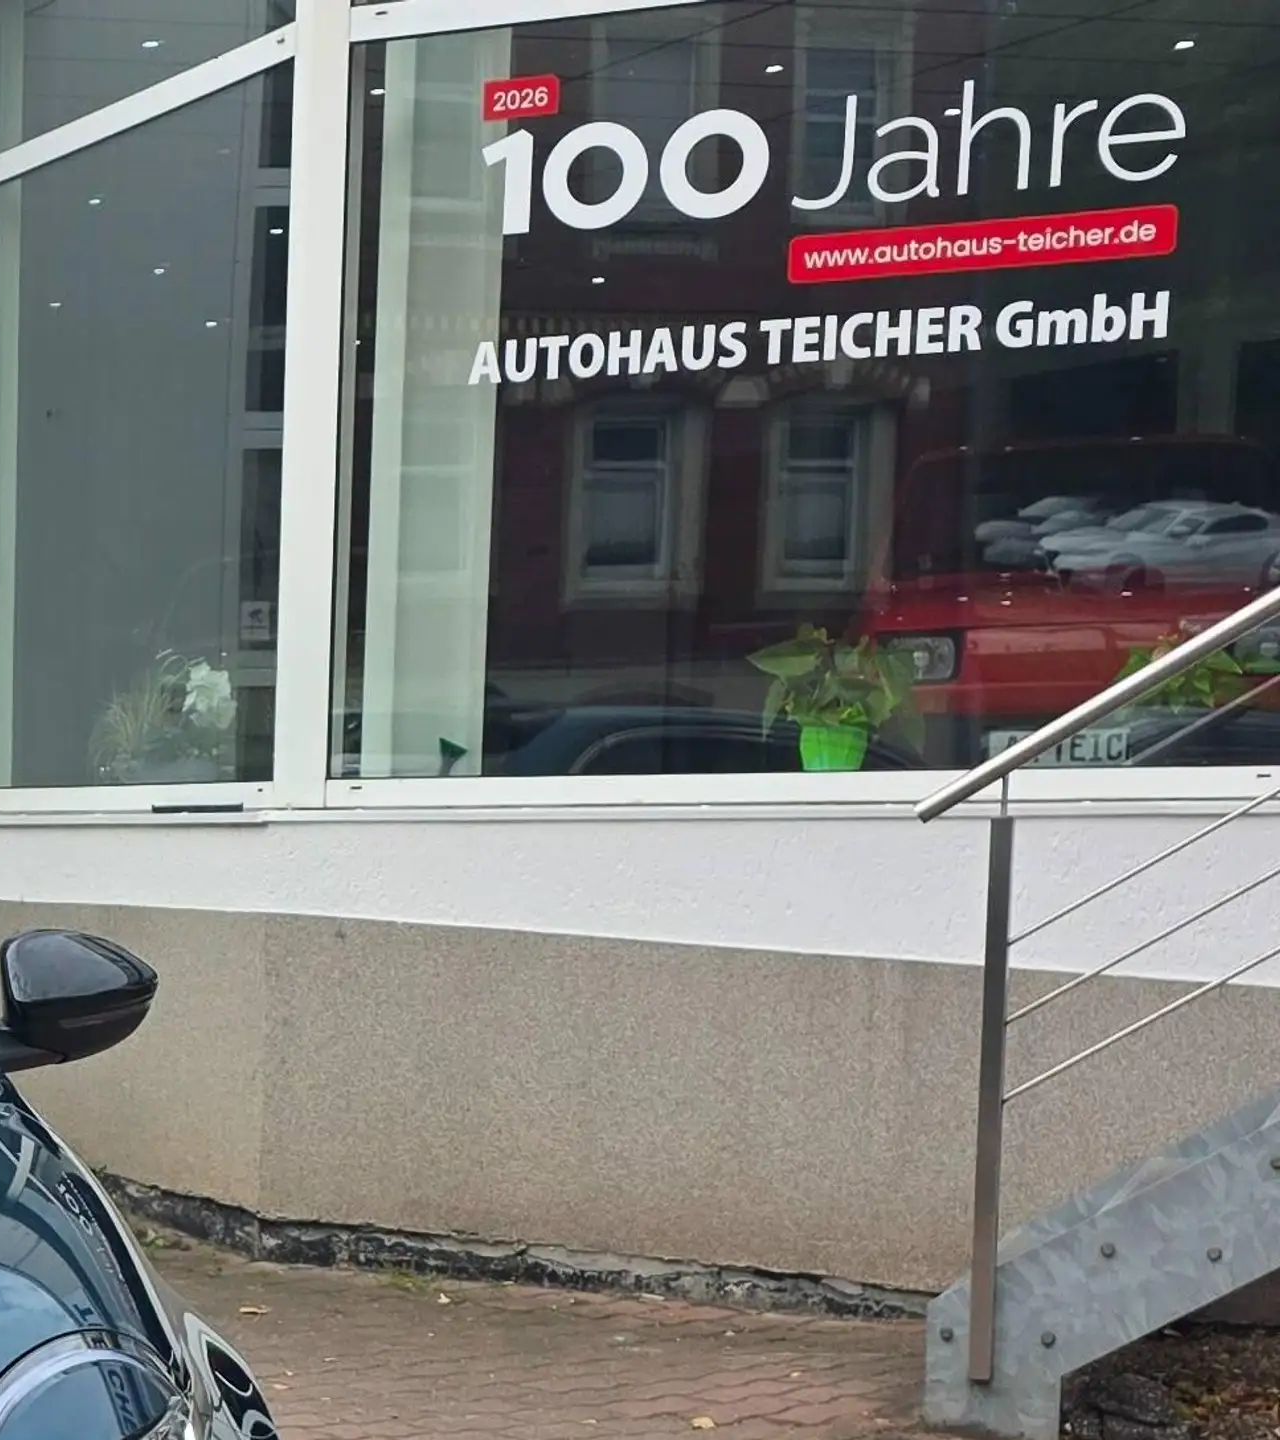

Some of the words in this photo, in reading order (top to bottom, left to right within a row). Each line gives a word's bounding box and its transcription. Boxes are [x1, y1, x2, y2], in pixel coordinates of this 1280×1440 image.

[492, 86, 549, 112] 2026
[481, 108, 769, 236] 100
[791, 79, 1186, 211] Jahre
[803, 220, 1157, 270] www.autohaus-teicher.de
[468, 321, 747, 385] AUTOHAUS
[759, 305, 982, 365] TEICHER
[995, 290, 1171, 348] GmbH
